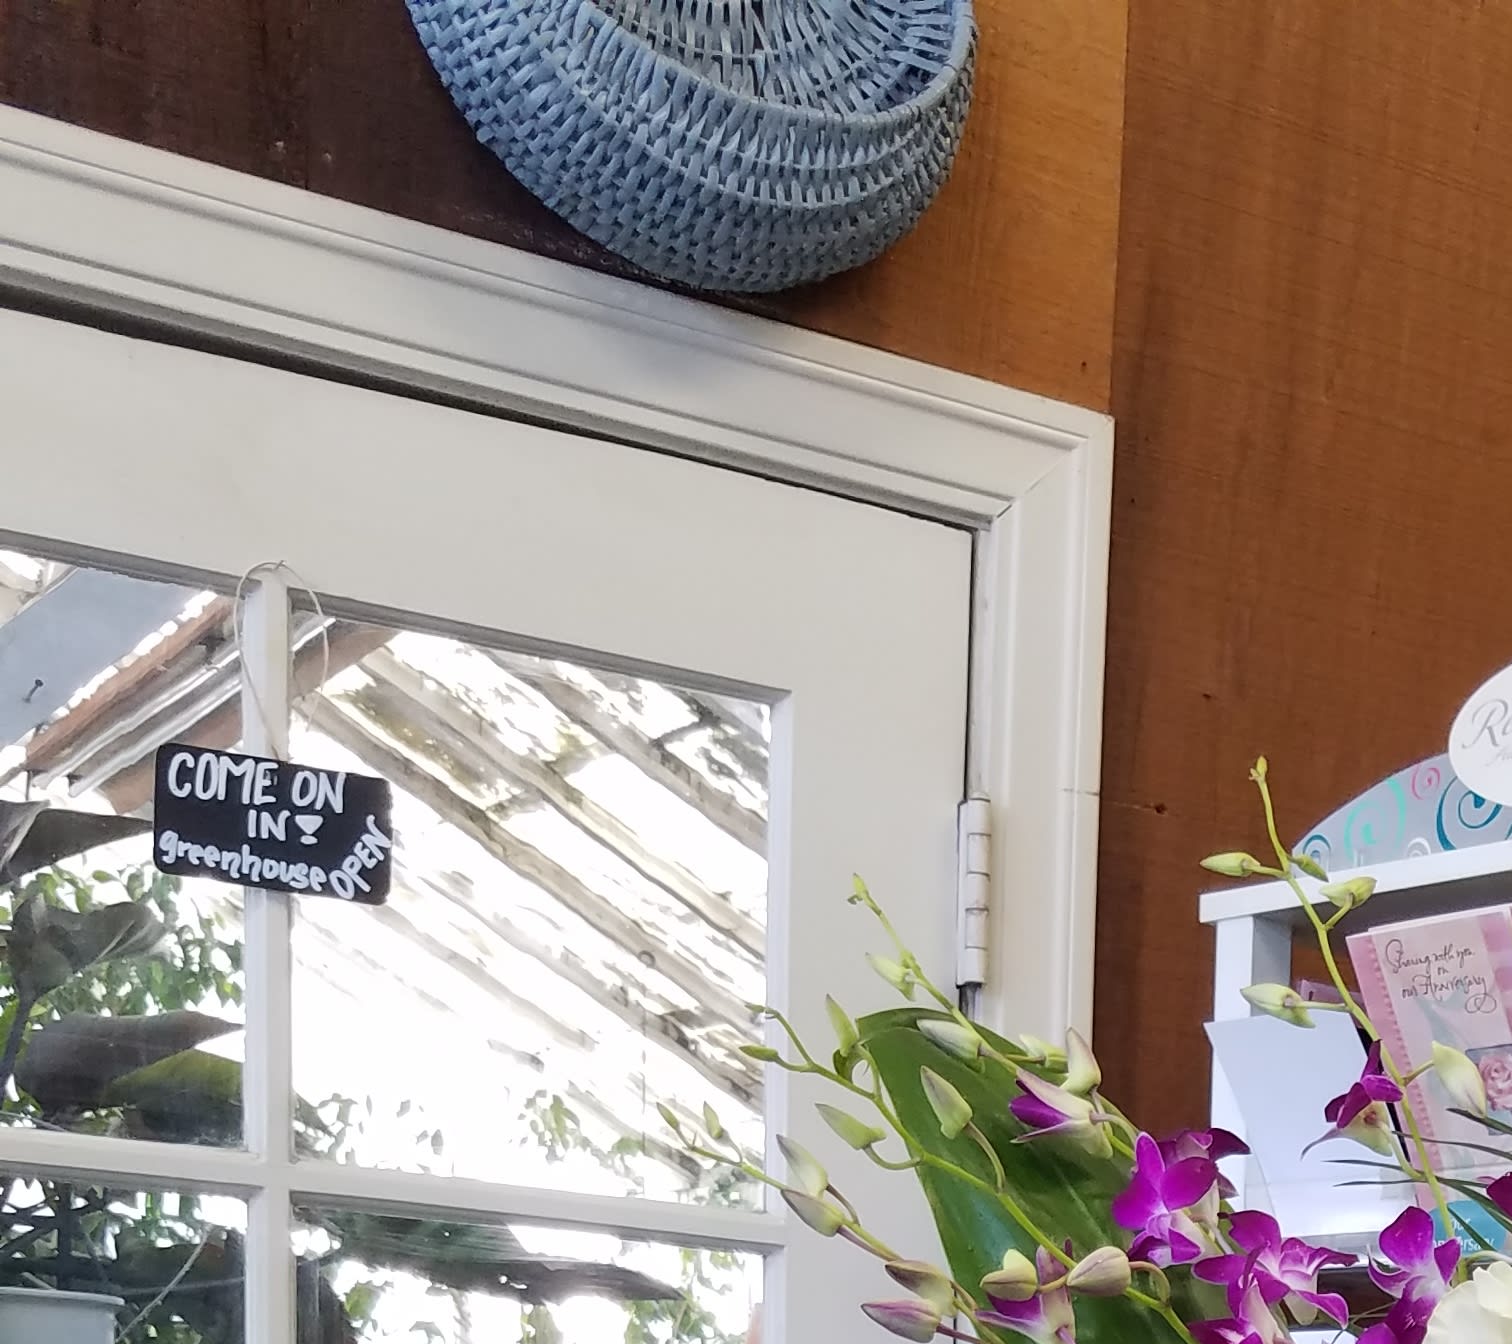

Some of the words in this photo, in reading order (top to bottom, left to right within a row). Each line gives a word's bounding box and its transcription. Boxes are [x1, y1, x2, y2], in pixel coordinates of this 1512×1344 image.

[168, 752, 279, 805] COME
[291, 770, 347, 814] ON
[159, 830, 327, 892] greenhouse
[328, 814, 393, 900] OPEN
